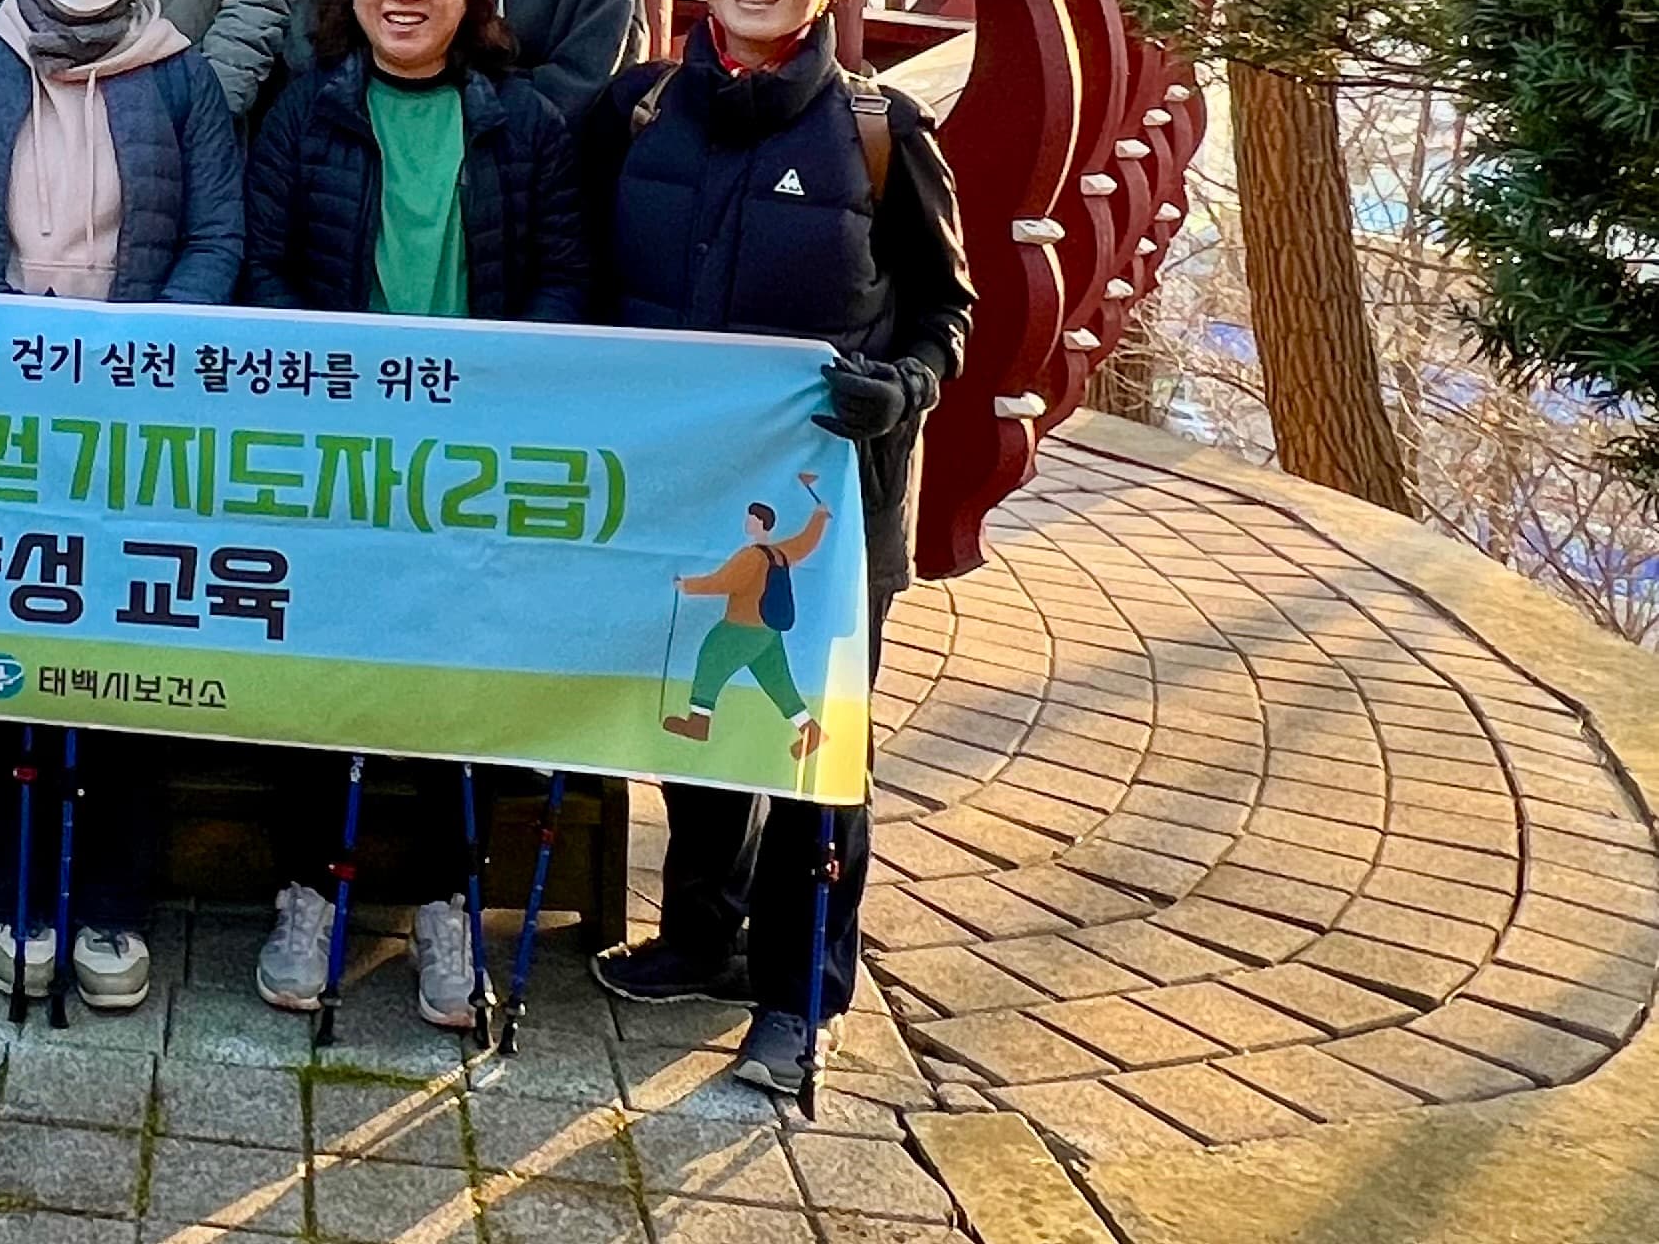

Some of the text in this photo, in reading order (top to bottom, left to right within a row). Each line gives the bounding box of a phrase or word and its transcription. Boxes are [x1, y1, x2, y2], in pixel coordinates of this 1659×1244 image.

[11, 334, 83, 384] 걷기
[99, 339, 177, 389] 실천
[192, 343, 361, 400] 활성화를
[375, 355, 461, 405] 위한
[114, 540, 291, 643] 교육
[37, 665, 229, 709] 태백시보건소
